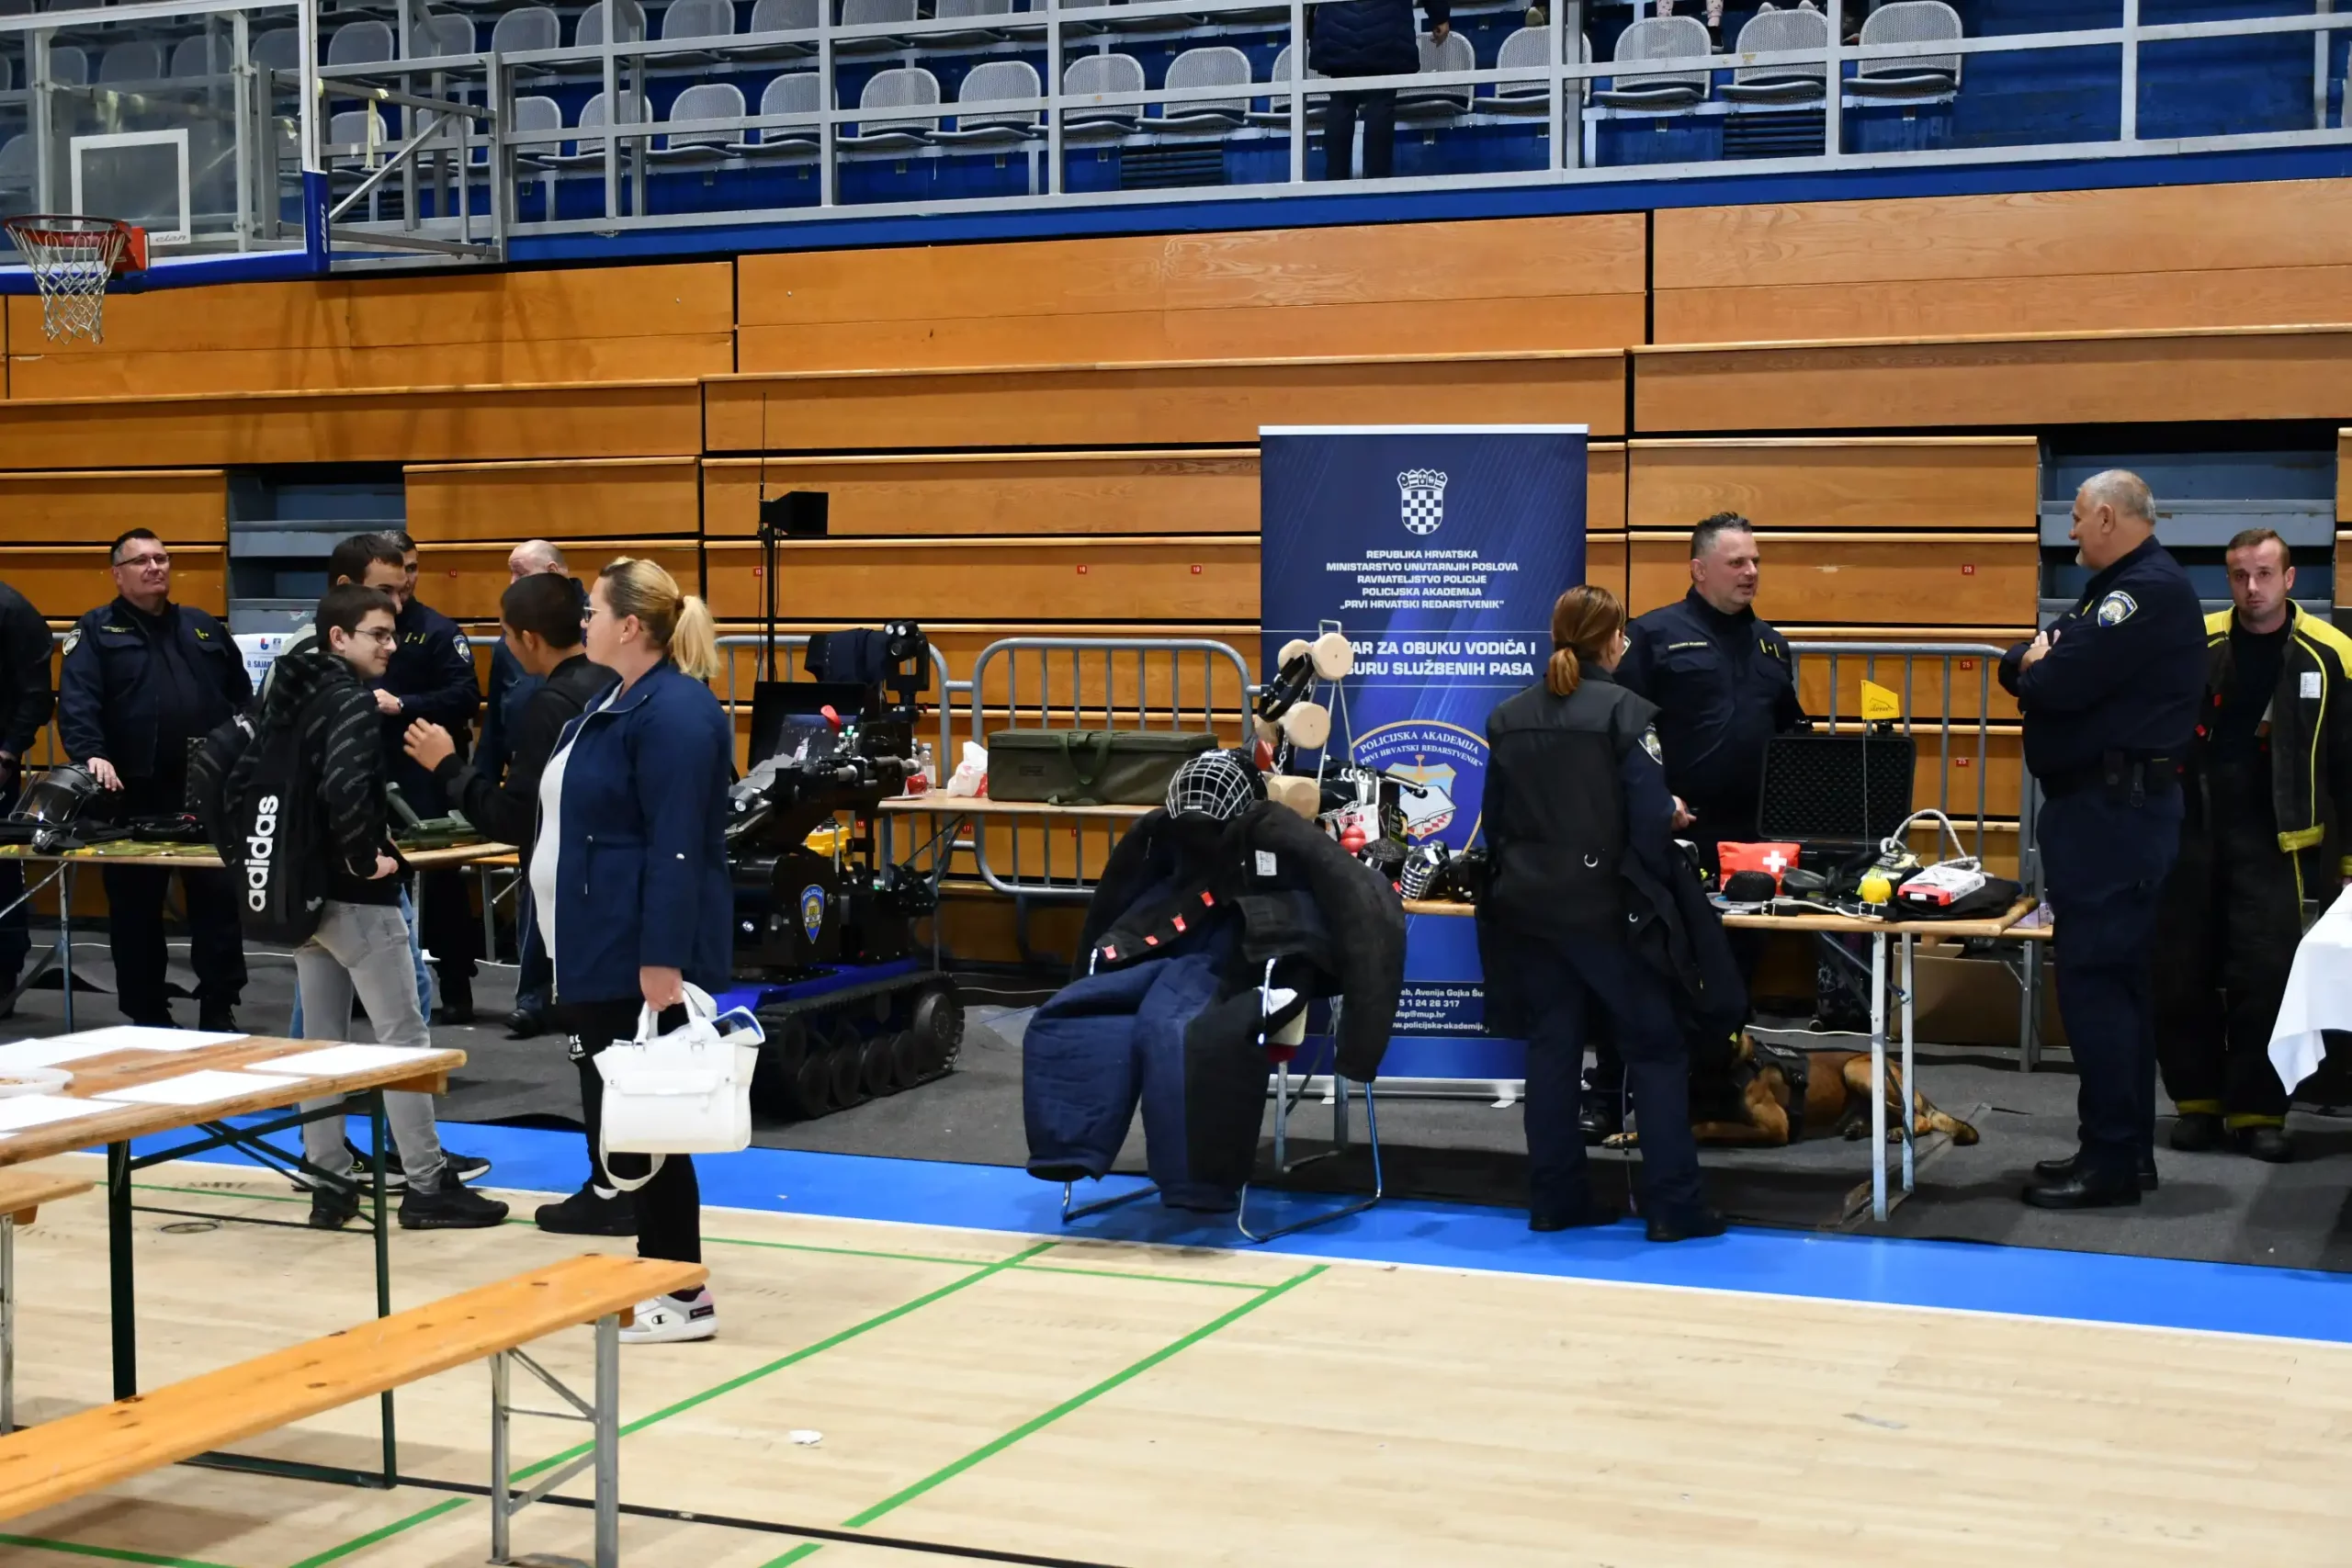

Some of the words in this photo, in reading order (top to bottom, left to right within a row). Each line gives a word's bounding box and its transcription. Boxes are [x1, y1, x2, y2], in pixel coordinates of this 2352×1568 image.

[1366, 550, 1422, 558] REPUBLIKA
[1424, 550, 1477, 558] HRVATSKA
[1326, 563, 1402, 571] MINISTARSTVO
[1404, 563, 1469, 571] UNUTARNJIH
[1472, 563, 1519, 571] POSLOVA
[1357, 575, 1441, 583] RAVNATELJSTVO
[1443, 575, 1487, 583] POLICIJE
[1362, 587, 1419, 596] POLICIJSKA
[1422, 587, 1482, 596] AKADEMIJA
[1370, 600, 1419, 609] HRVATSKI
[1376, 641, 1399, 655] ZA
[1402, 641, 1461, 655] OBUKU
[1464, 638, 1527, 655] VODIČA
[1531, 641, 1535, 655] I
[1393, 659, 1485, 675] SLUŽBENIH
[1489, 661, 1534, 675] PASA
[1359, 731, 1418, 754] POLICIJSKA
[1421, 731, 1478, 755] AKADEMIJA
[1379, 745, 1419, 758] HRVATSKI
[243, 795, 279, 912] adidas
[1400, 988, 1413, 997] eb,
[1415, 988, 1444, 998] Avenija
[1446, 989, 1470, 998] Gojka
[1472, 987, 1485, 998] Šu
[1429, 999, 1441, 1008] 26
[1443, 999, 1460, 1008] 317
